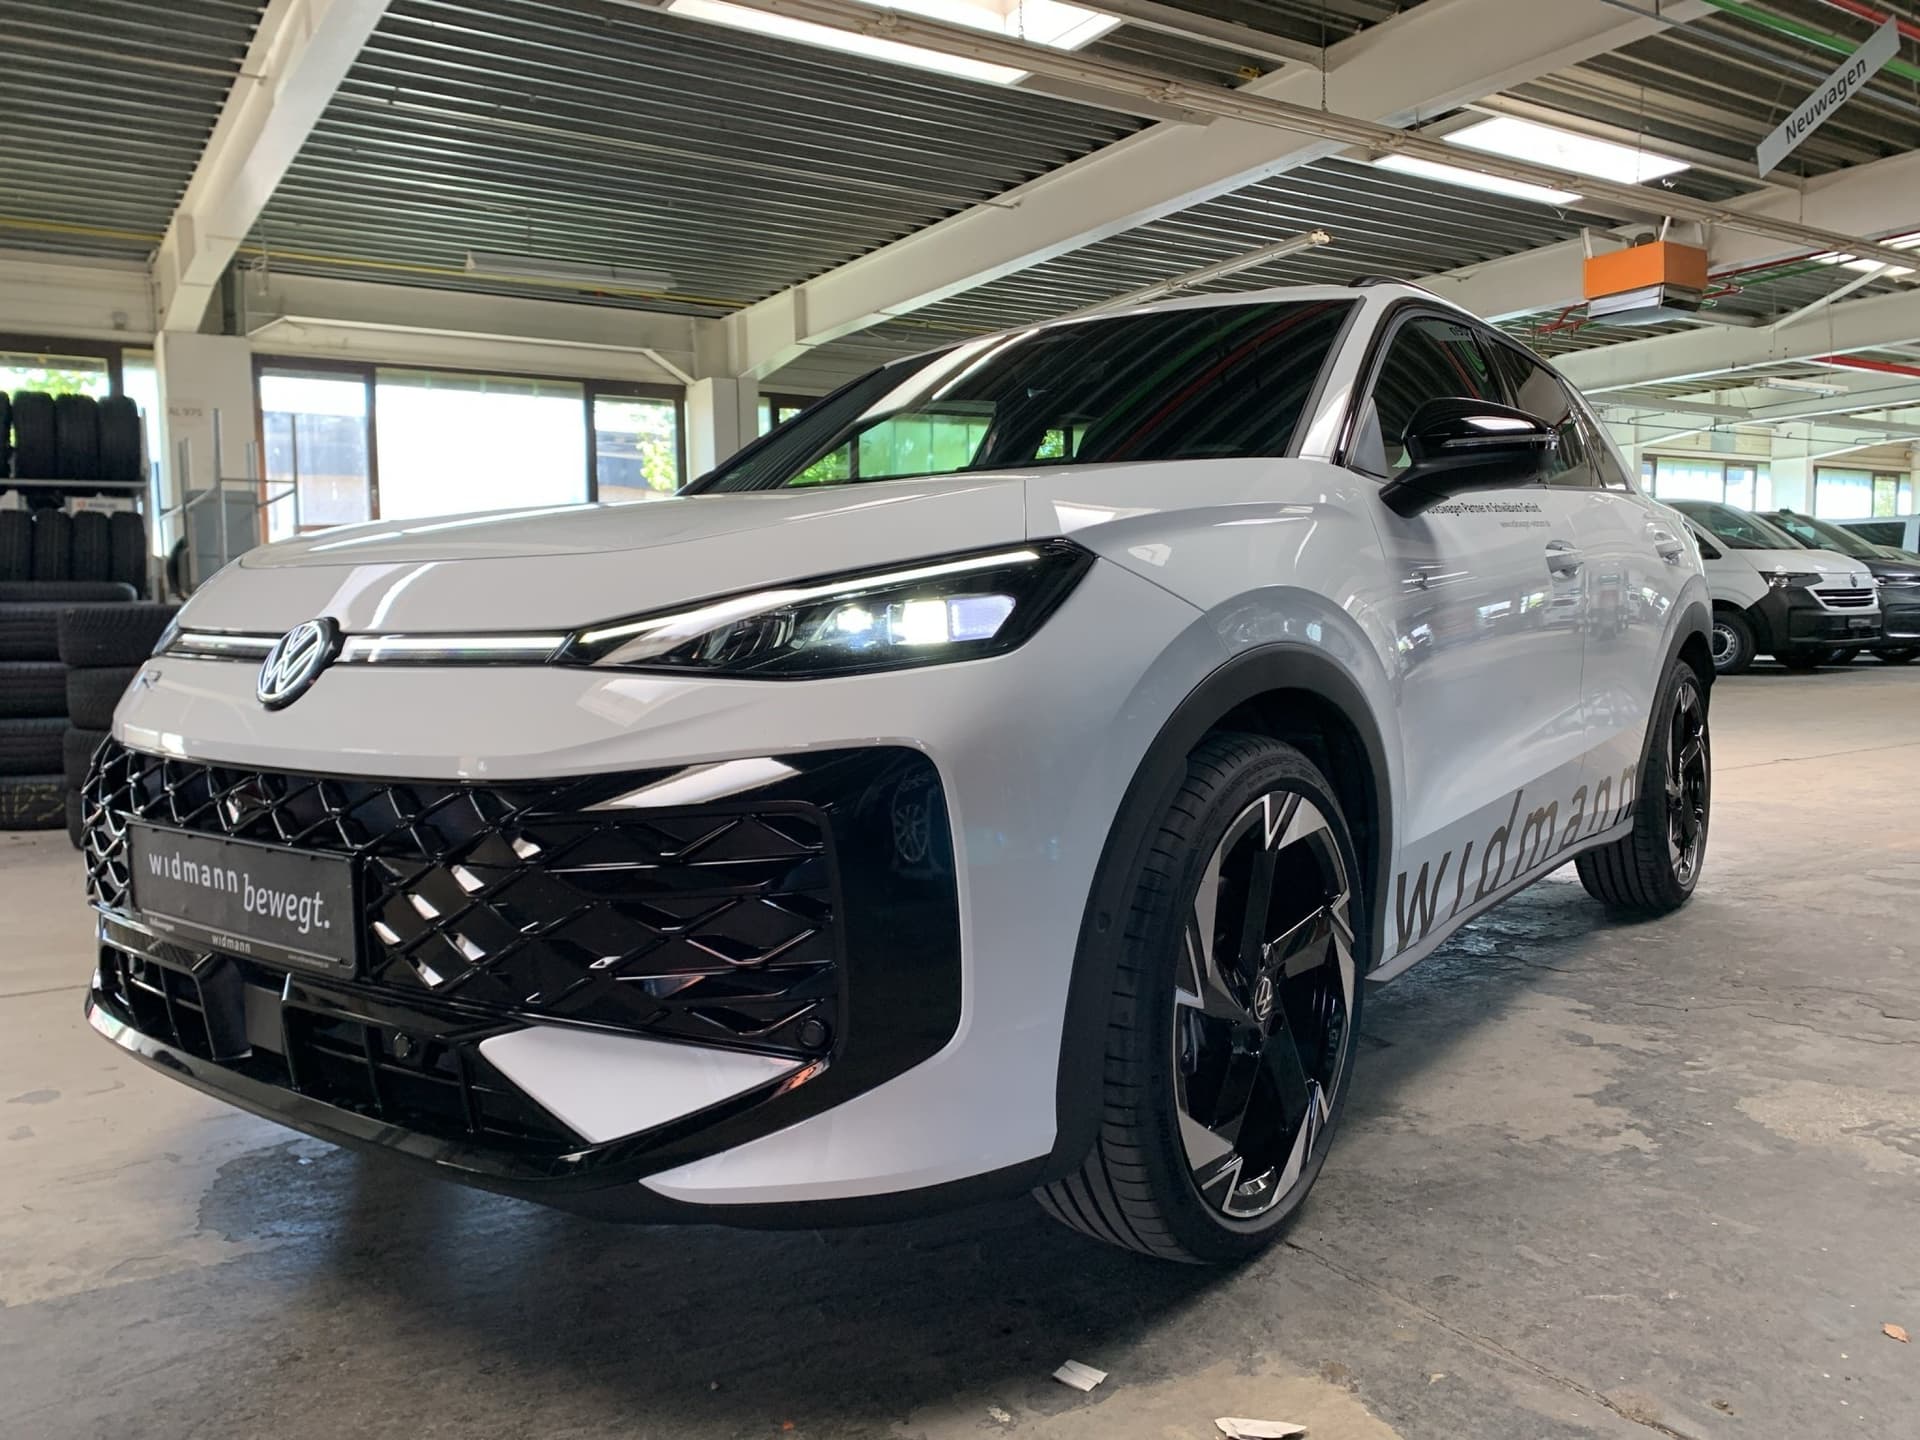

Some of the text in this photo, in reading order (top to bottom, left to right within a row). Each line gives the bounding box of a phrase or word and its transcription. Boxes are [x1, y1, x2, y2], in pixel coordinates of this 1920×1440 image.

[1785, 58, 1867, 145] Neuwagen
[148, 851, 331, 935] widmann bewegt.
[211, 933, 252, 954] widmann
